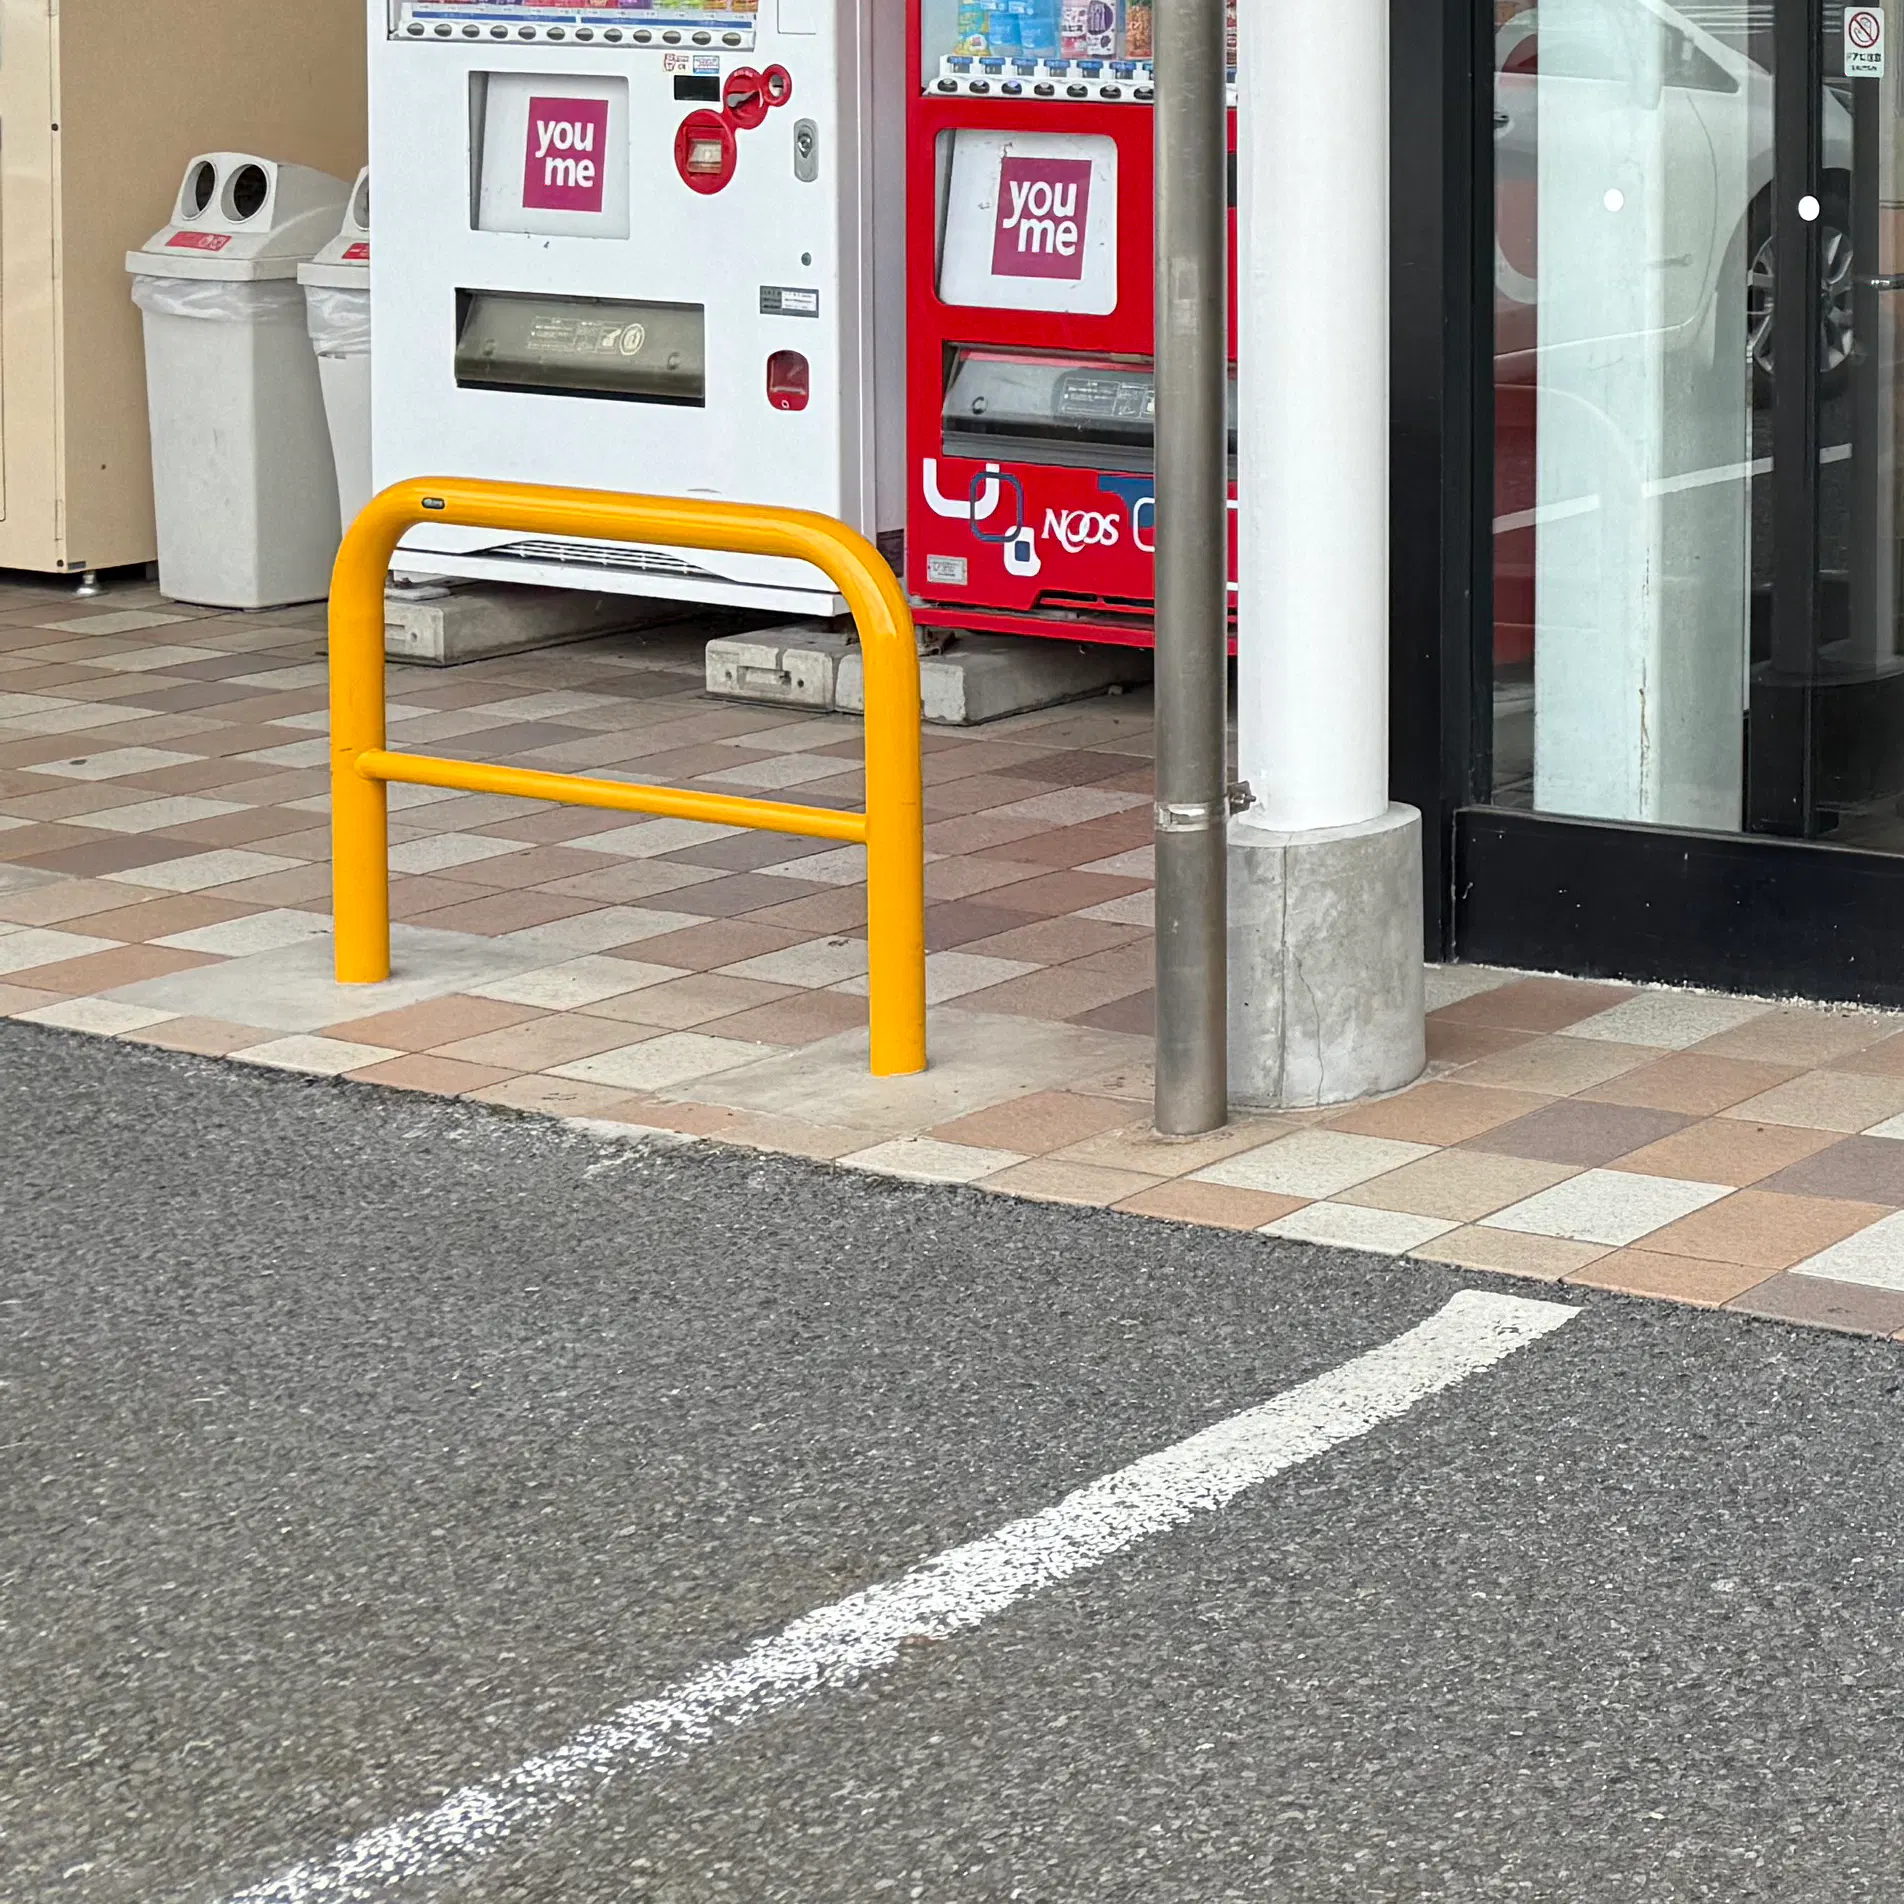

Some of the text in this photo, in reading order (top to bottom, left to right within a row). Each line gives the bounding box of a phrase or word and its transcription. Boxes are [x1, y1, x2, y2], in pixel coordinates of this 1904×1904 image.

[536, 120, 595, 159] you
[544, 156, 597, 189] me
[1004, 181, 1078, 229] you
[1019, 217, 1078, 258] me
